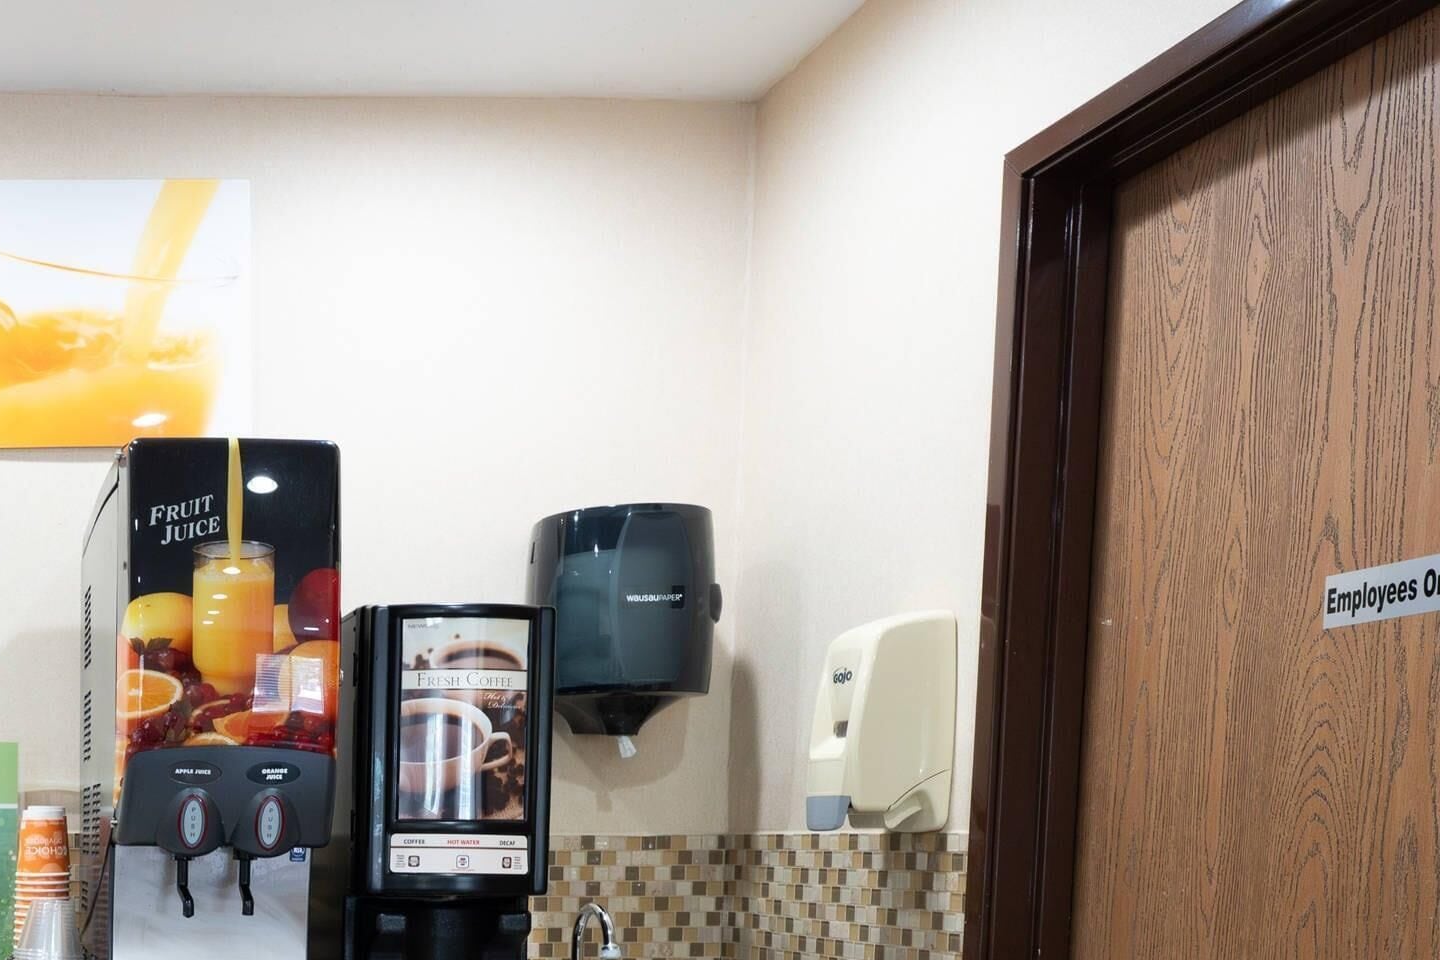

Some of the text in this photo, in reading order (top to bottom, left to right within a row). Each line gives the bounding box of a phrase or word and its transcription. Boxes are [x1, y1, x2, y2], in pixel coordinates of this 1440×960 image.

[149, 494, 214, 527] FRUIT
[161, 516, 220, 545] JUICE
[1327, 579, 1418, 618] Employees
[417, 672, 513, 688] FRESH COFFEE
